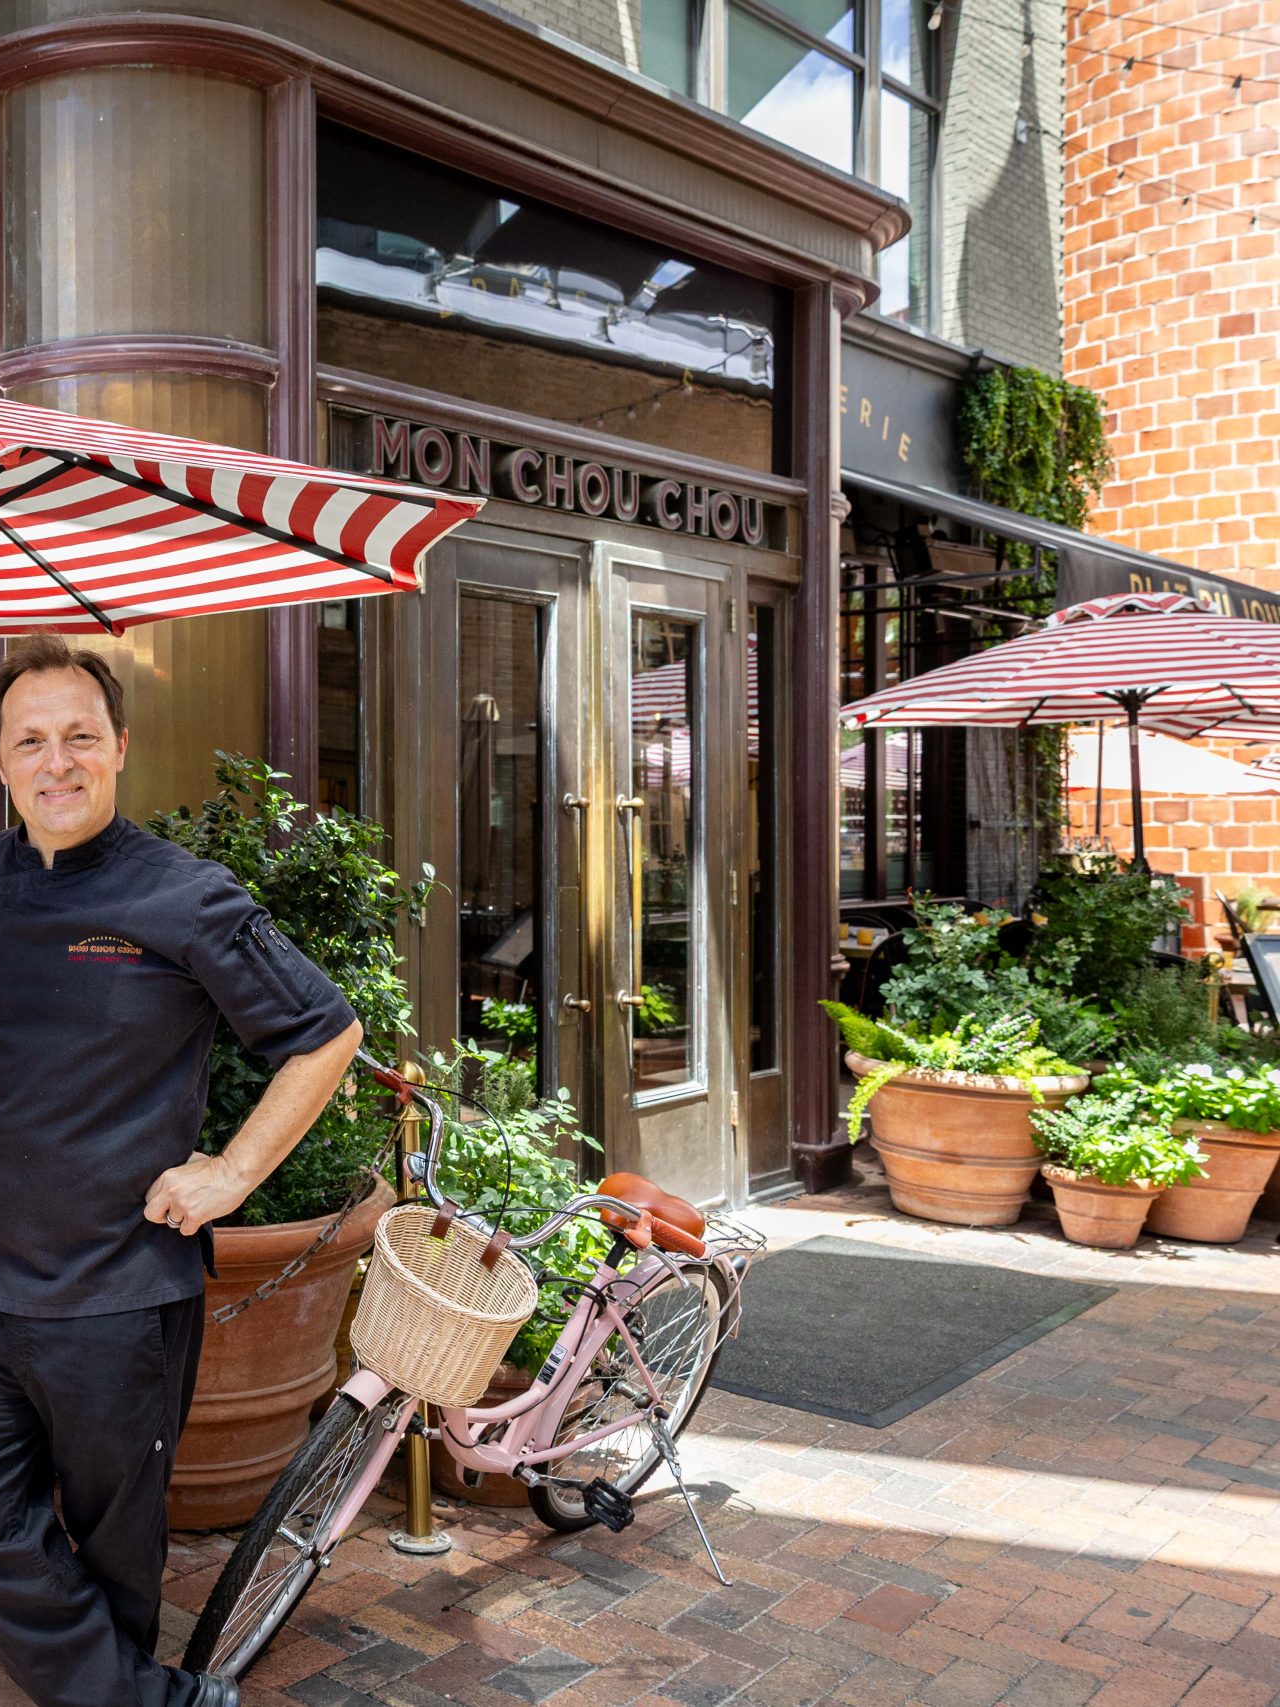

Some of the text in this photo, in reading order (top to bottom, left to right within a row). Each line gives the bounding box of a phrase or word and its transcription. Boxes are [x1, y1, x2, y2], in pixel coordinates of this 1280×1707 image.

[372, 414, 765, 546] MON CHOU CHOU
[90, 945, 116, 954] CHOU
[117, 946, 143, 955] CHOU
